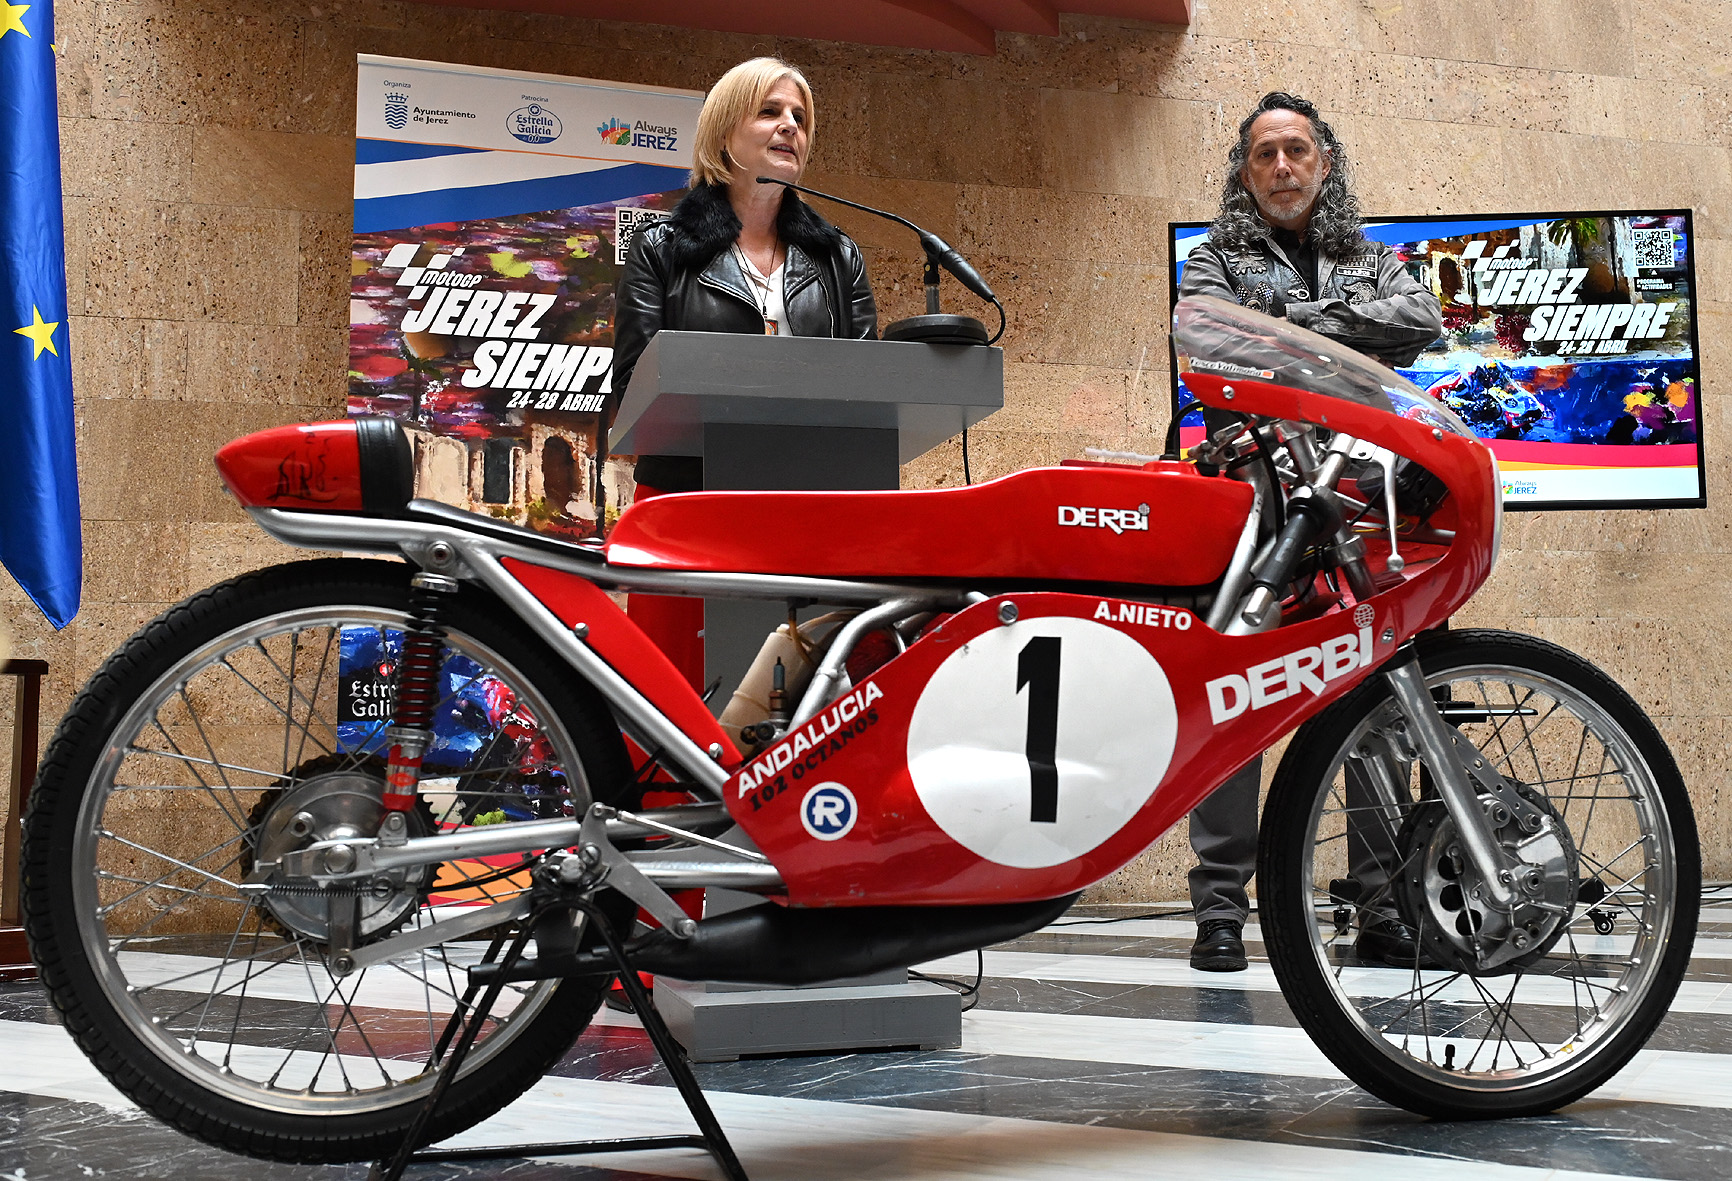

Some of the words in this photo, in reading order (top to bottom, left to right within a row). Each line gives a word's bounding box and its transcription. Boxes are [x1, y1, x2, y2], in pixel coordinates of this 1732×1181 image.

[384, 80, 411, 88] Organiza
[521, 94, 548, 102] Patrocina
[413, 106, 476, 119] Ayuntamiento
[426, 116, 448, 124] Jerez
[516, 114, 553, 126] Estrella
[517, 124, 551, 135] Galicia
[634, 120, 677, 137] Always
[631, 133, 677, 151] JEREZ
[1478, 268, 1589, 306] JEREZ
[401, 286, 558, 340] JEREZ
[1522, 303, 1677, 342] SIEMPRE
[1595, 339, 1629, 354] ABRIL
[461, 340, 614, 394] SIEMP
[559, 393, 606, 412] ABRIL
[1514, 487, 1537, 495] JEREZ
[1094, 601, 1192, 631] A.NIETO
[349, 680, 397, 697] Estr
[352, 698, 391, 717] Gali
[1016, 636, 1062, 823] 1
[738, 681, 884, 799] ANDALUCIA
[750, 775, 788, 811] 102
[792, 708, 879, 780] OCTANOS
